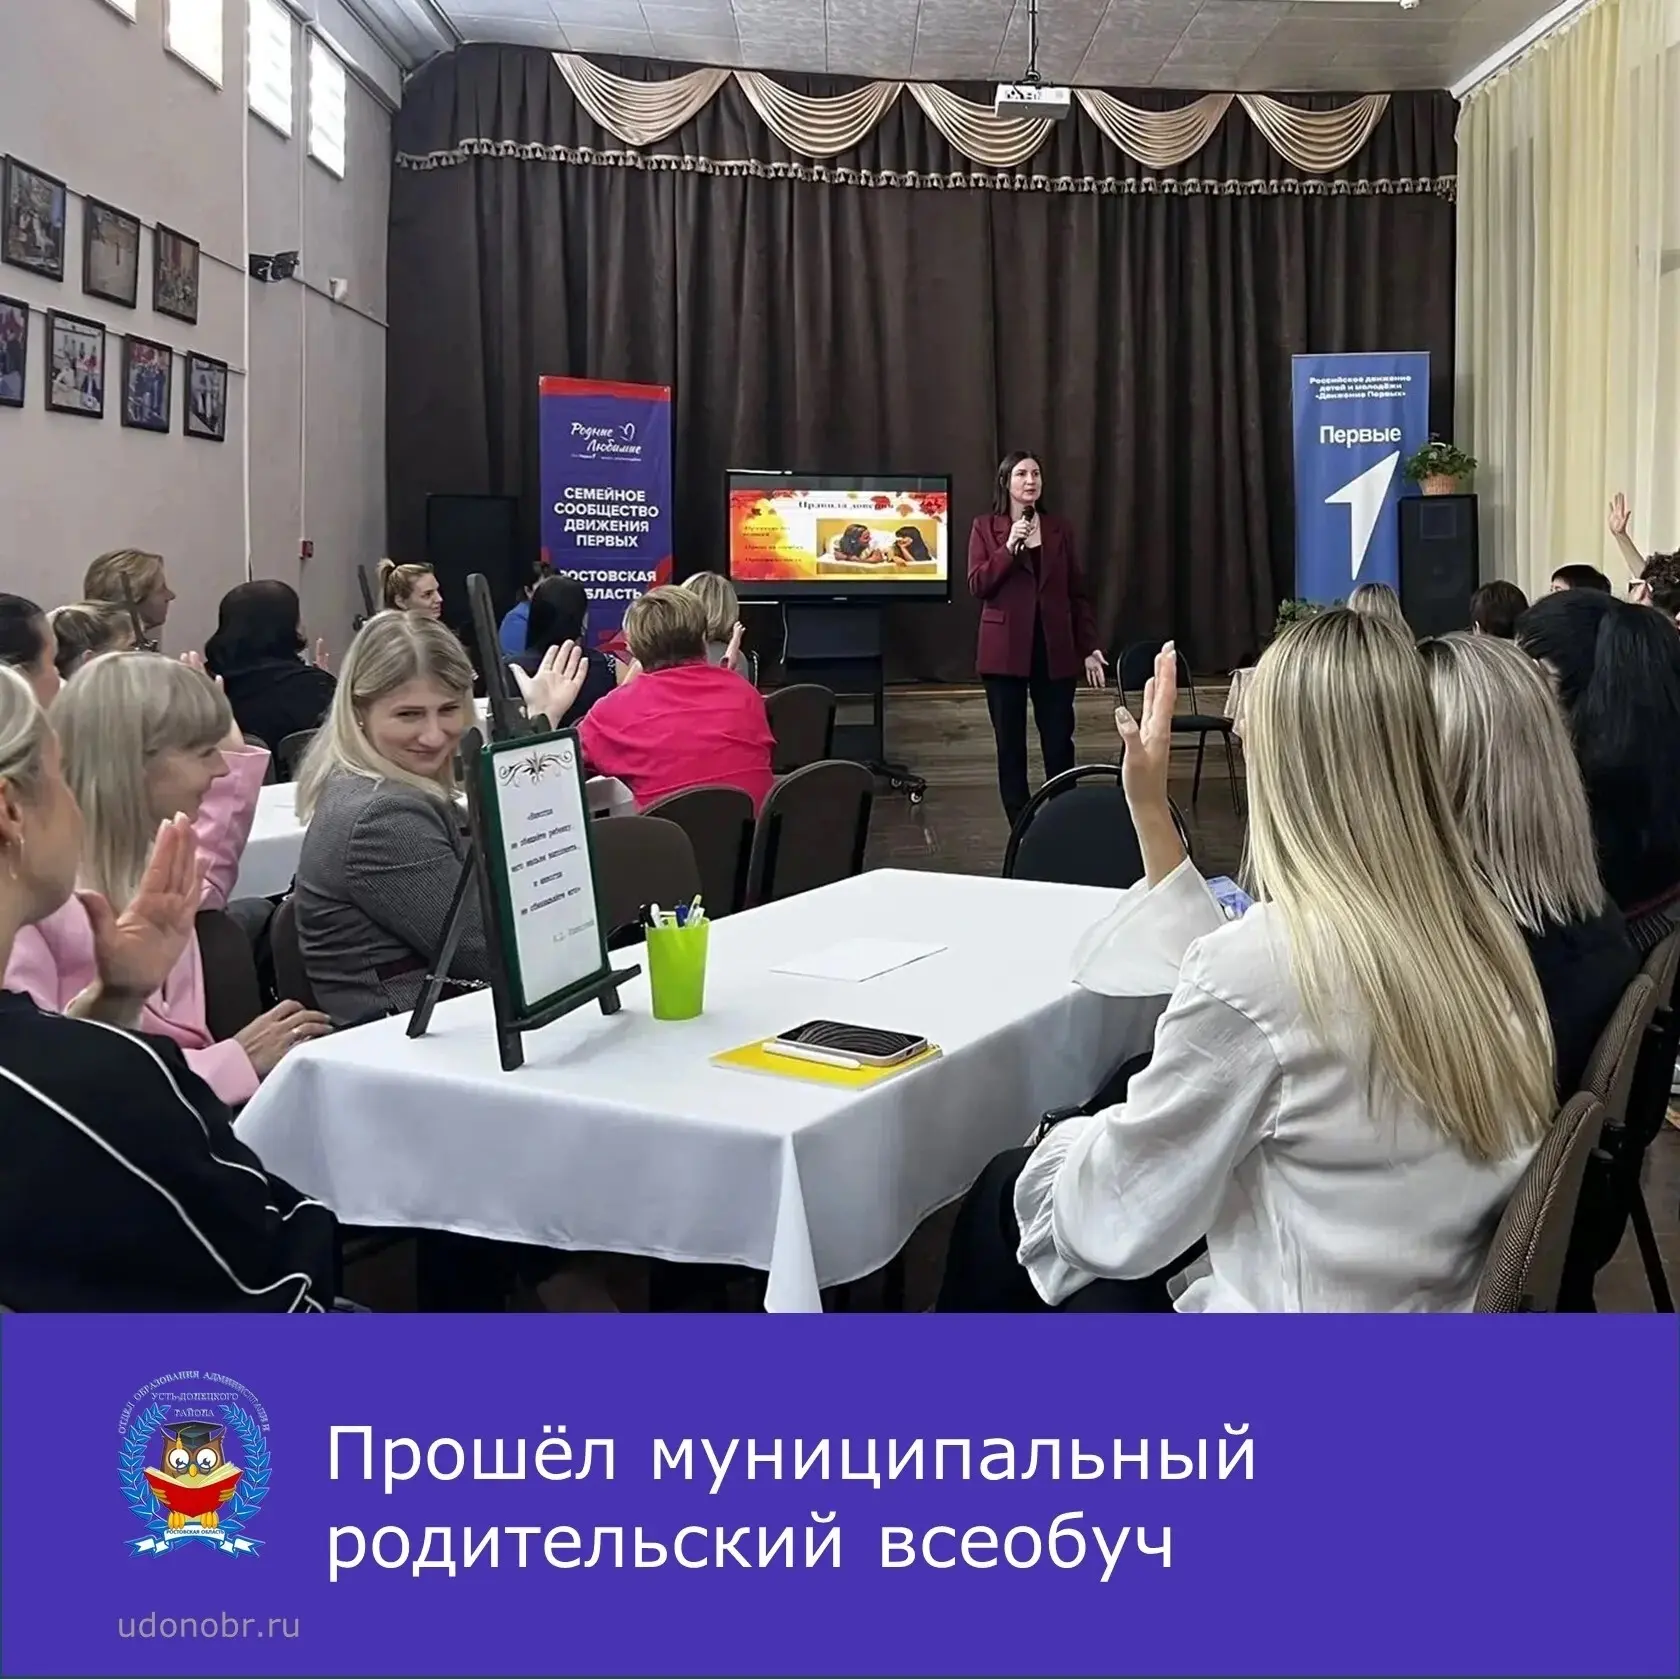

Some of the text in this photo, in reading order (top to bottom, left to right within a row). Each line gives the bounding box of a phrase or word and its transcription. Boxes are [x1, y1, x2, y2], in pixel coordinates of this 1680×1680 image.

[1309, 375, 1412, 385] Российское движение
[571, 422, 613, 441] Родные
[1319, 425, 1401, 448] Первые
[587, 438, 642, 454] Любимые
[564, 487, 646, 502] СЕМЕЙНОЕ
[554, 502, 659, 518] СООБЩЕСТВО
[564, 518, 649, 533] ДВИЖЕНИЯ
[576, 534, 638, 548] ПЕРВЫХ
[584, 588, 642, 600] БЛАСТЬ
